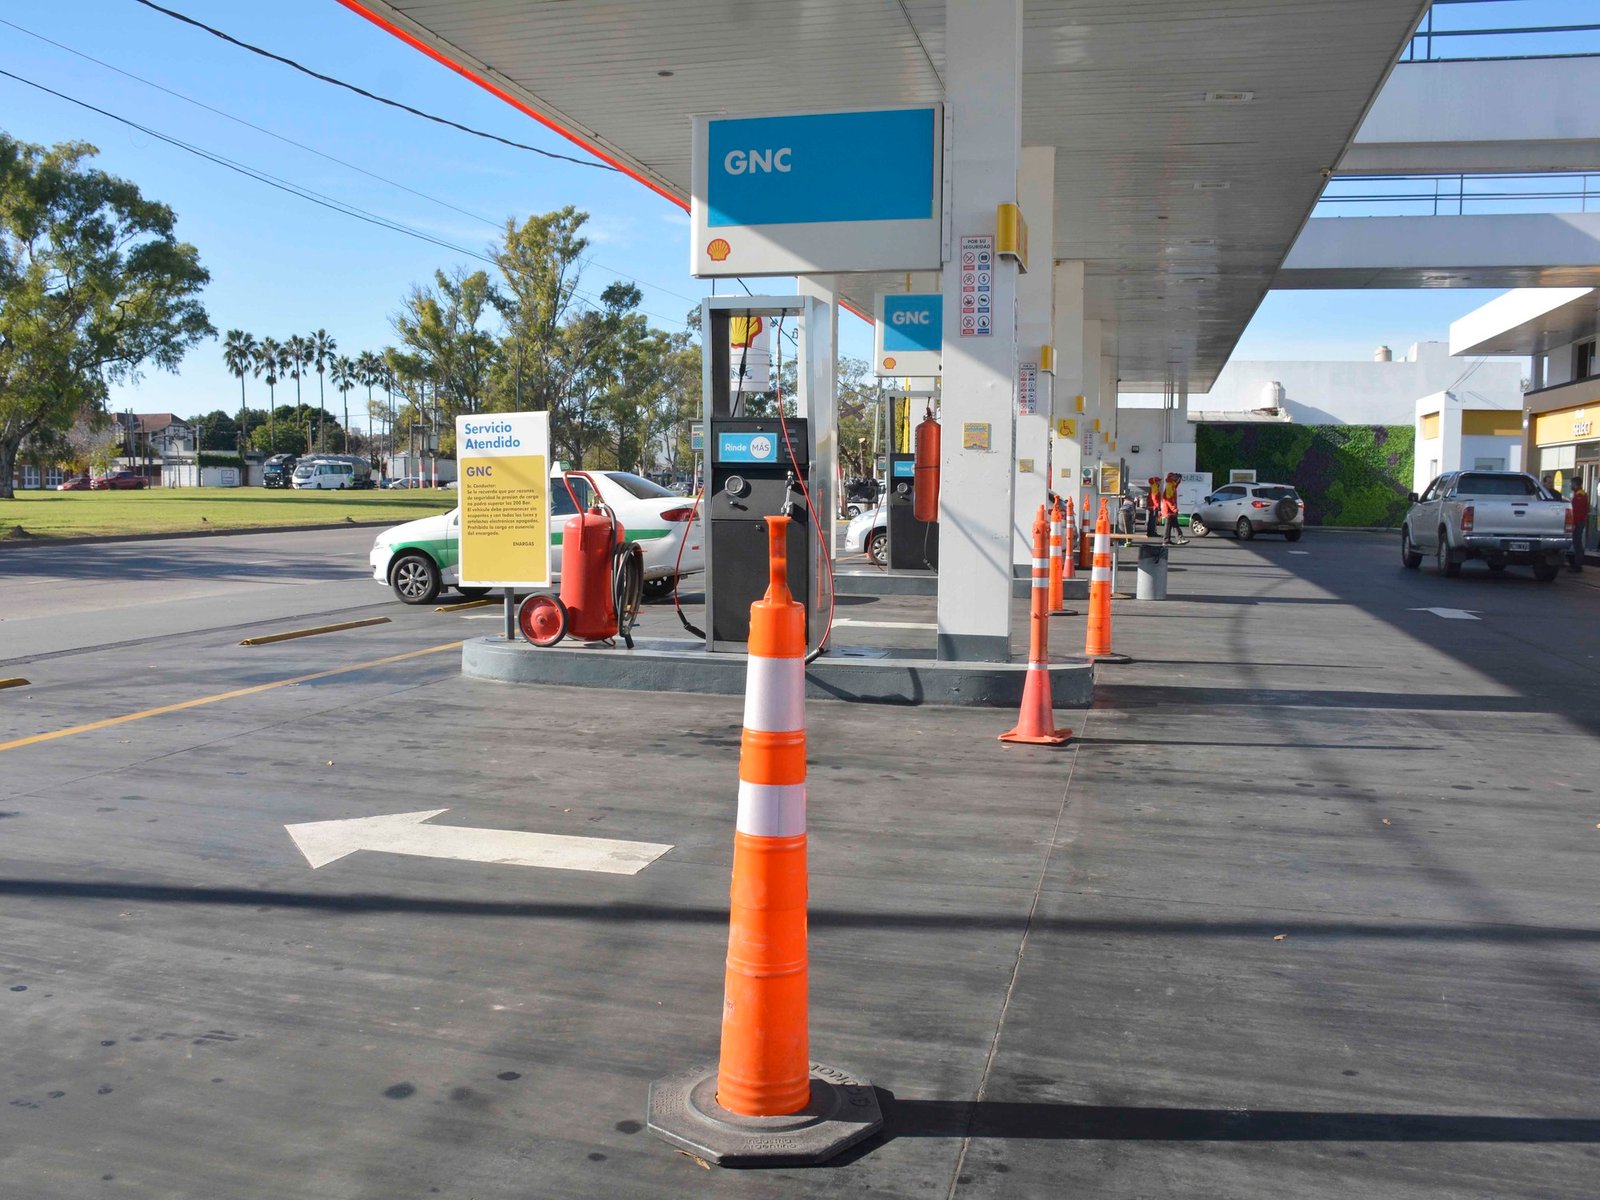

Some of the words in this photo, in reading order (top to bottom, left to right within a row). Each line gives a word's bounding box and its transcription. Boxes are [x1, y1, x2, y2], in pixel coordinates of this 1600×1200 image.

[724, 147, 792, 175] GNC
[892, 310, 930, 325] GNC
[464, 421, 512, 435] Servicio
[465, 435, 521, 450] Atendido
[725, 443, 747, 451] Rinde
[751, 442, 770, 452] MÁS
[466, 466, 493, 476] GNC
